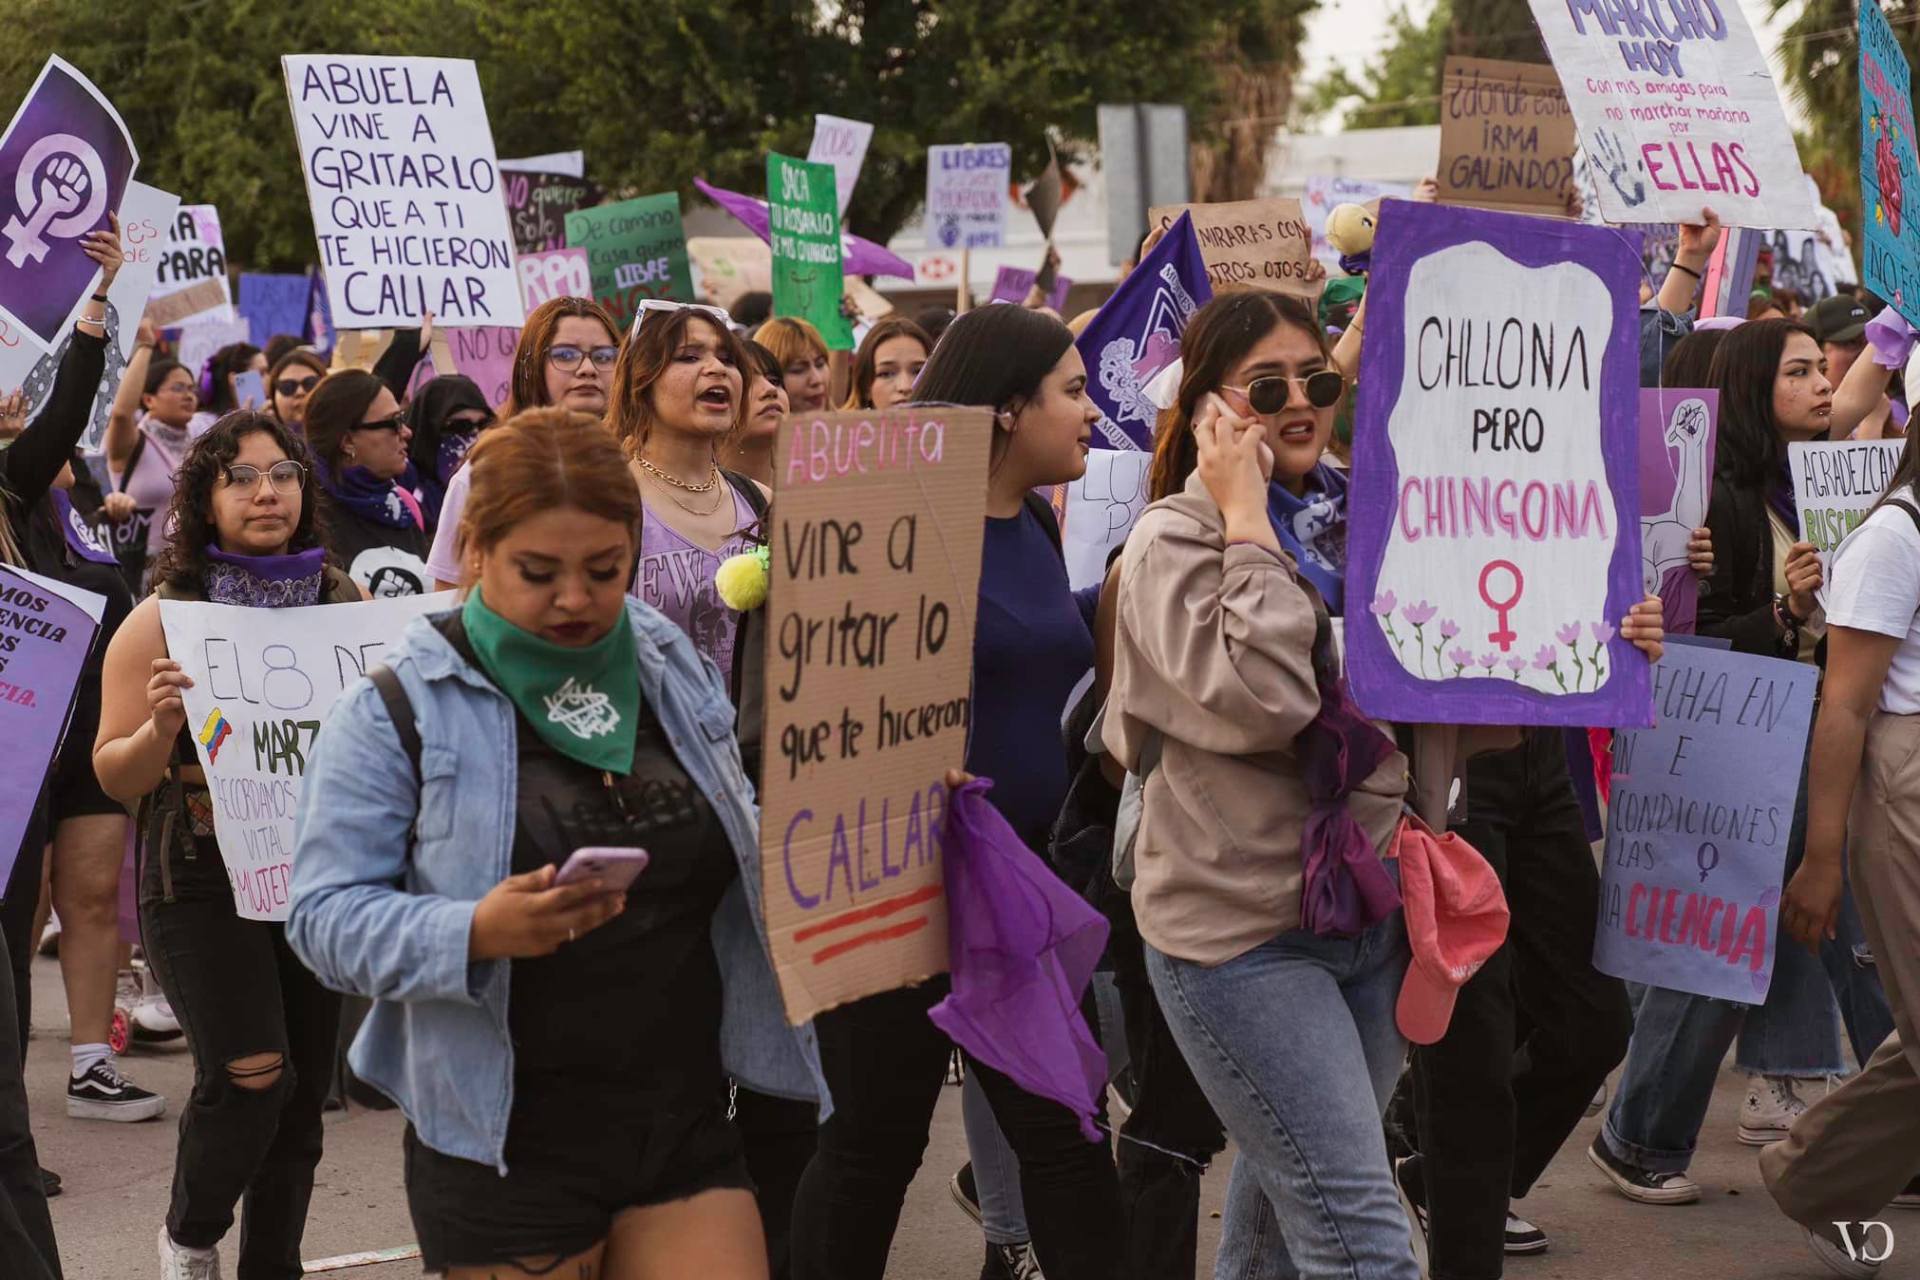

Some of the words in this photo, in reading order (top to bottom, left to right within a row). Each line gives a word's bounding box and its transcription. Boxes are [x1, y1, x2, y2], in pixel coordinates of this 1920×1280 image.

[1566, 0, 1728, 42] MARCHO
[1619, 40, 1684, 78] HOY
[303, 64, 454, 108] ABUELA
[1616, 79, 1640, 95] mis
[1645, 81, 1696, 101] amigas
[1699, 82, 1728, 99] para
[312, 112, 390, 140] VINE
[412, 114, 436, 143] A
[1605, 106, 1623, 121] no
[1630, 102, 1692, 121] marchar
[1696, 106, 1751, 124] mañana
[1669, 120, 1690, 137] por
[311, 146, 494, 193] GRITARLO
[780, 161, 810, 202] SACA
[1641, 141, 1760, 197] ELLAS
[332, 196, 397, 230] QUE
[405, 200, 426, 226] A
[434, 202, 464, 229] TI
[1199, 222, 1273, 249] MIRARAS
[1277, 218, 1306, 240] CON
[157, 246, 225, 283] PARA
[319, 235, 354, 266] TE
[372, 235, 510, 269] HICIERON
[1264, 261, 1305, 279] OJOS
[344, 271, 491, 318] CALLAR
[458, 327, 488, 362] NO
[1472, 406, 1544, 453] PERO
[1399, 475, 1608, 543] CHINGONA
[779, 600, 899, 701] gritar
[916, 594, 949, 661] lo
[1736, 676, 1794, 733] EN
[780, 719, 831, 780] que
[877, 695, 969, 750] hicieron
[1615, 789, 1779, 847] CONDICIONES
[242, 823, 291, 861] VITAL
[783, 779, 947, 909] CALLAR
[1626, 881, 1769, 974] CIENCIA
